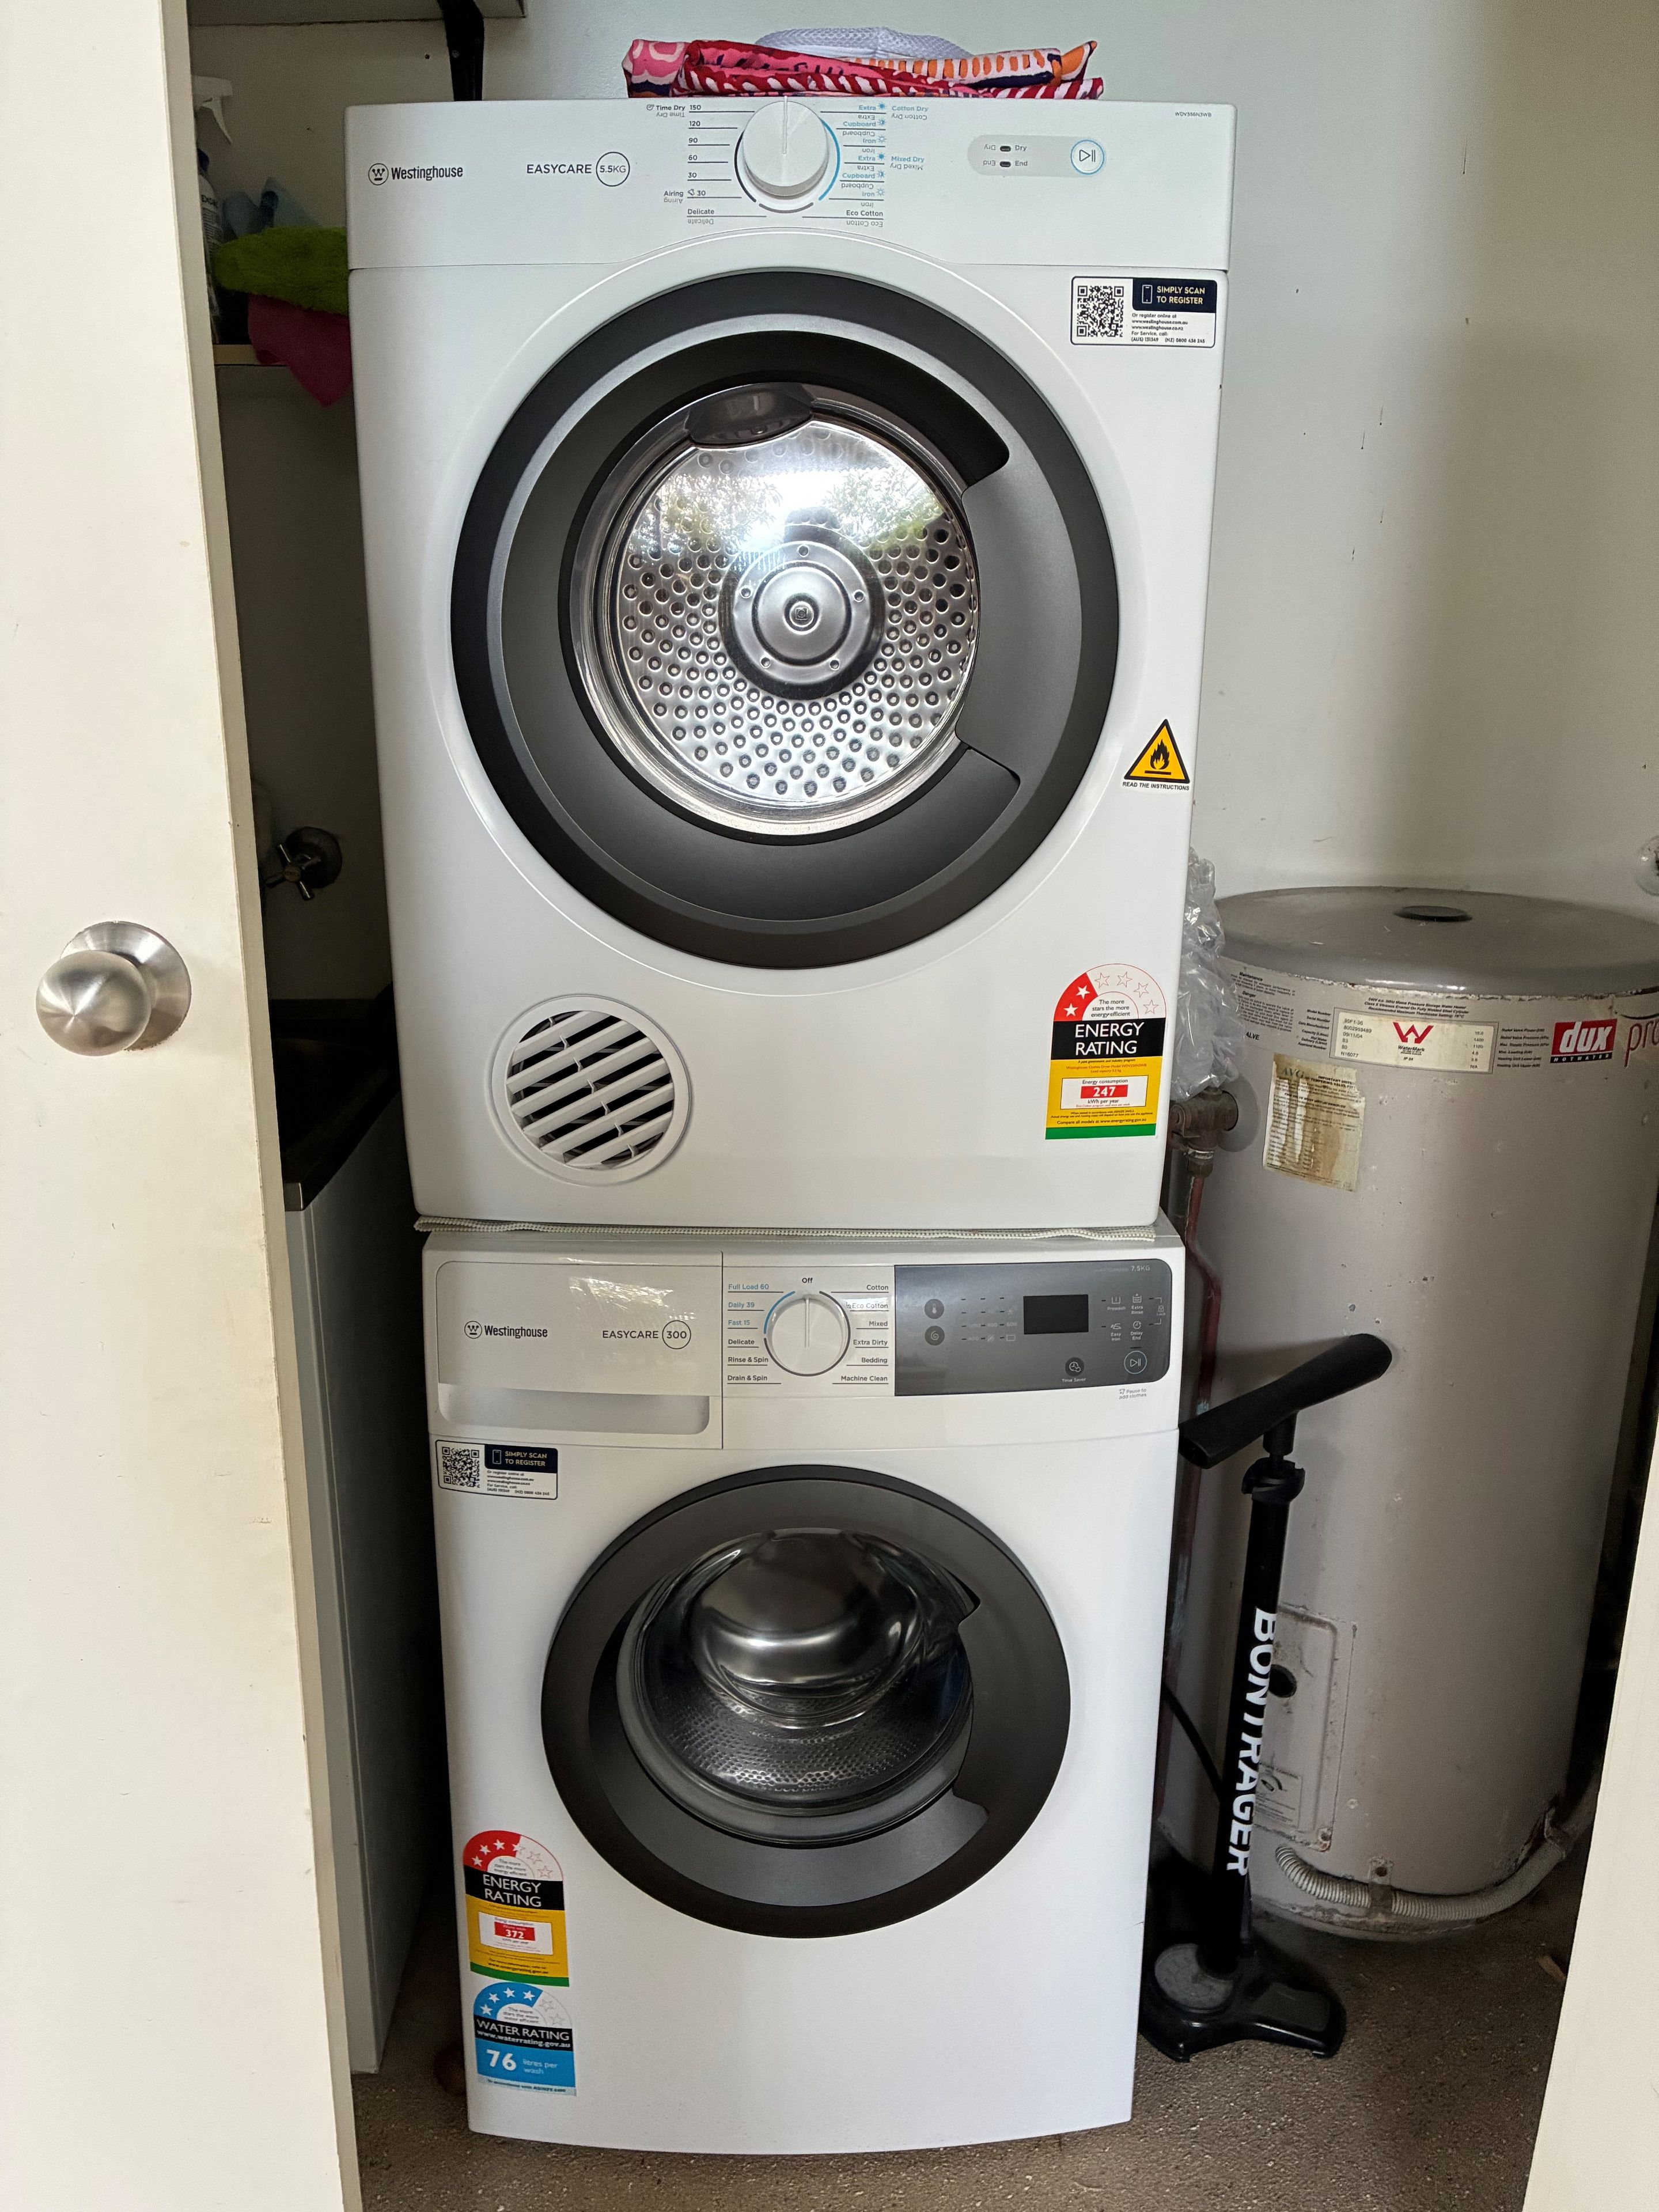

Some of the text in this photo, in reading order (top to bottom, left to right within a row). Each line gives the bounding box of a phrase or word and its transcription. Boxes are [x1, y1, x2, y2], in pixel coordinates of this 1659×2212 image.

[391, 166, 463, 181] Westinghouse
[527, 164, 626, 174] EASYCARE 5.5KG
[1075, 1022, 1145, 1037] ENERGY
[1559, 1021, 1612, 1053] dux
[1076, 1040, 1137, 1055] RATING
[1093, 1086, 1116, 1097] 247
[484, 1325, 548, 1339] Westinghouse
[603, 1331, 687, 1339] EASYCARE 300
[483, 1874, 541, 1893] ENERGY
[484, 1888, 541, 1907] RATING
[506, 1929, 524, 1939] 372
[476, 2019, 570, 2040] WATER RATING
[477, 2030, 570, 2048] www.waterrating.gov.au
[486, 2049, 517, 2071] 76
